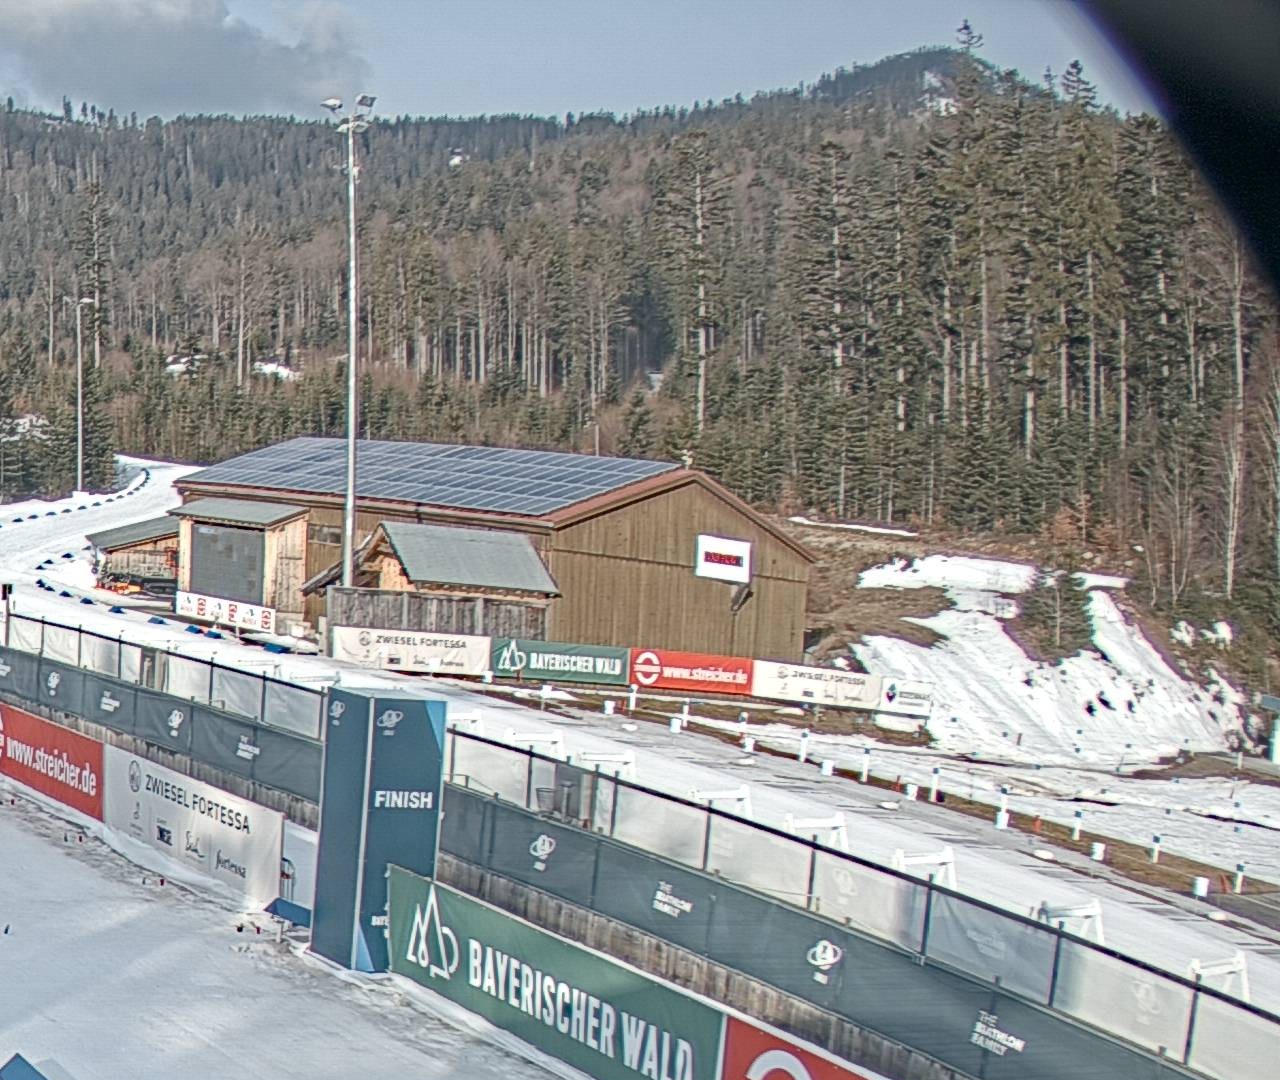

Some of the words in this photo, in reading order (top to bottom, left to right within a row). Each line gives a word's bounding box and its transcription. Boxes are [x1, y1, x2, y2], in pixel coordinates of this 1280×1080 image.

[530, 652, 593, 673] BAYERISCHER
[595, 657, 621, 675] WALD
[7, 738, 97, 797] www.streicher.de
[145, 774, 190, 809] ZWIESEL
[192, 793, 251, 834] FORTESSA
[374, 790, 433, 809] FINISH
[469, 938, 617, 1061] BAYERISCHER
[977, 1010, 999, 1028] THE
